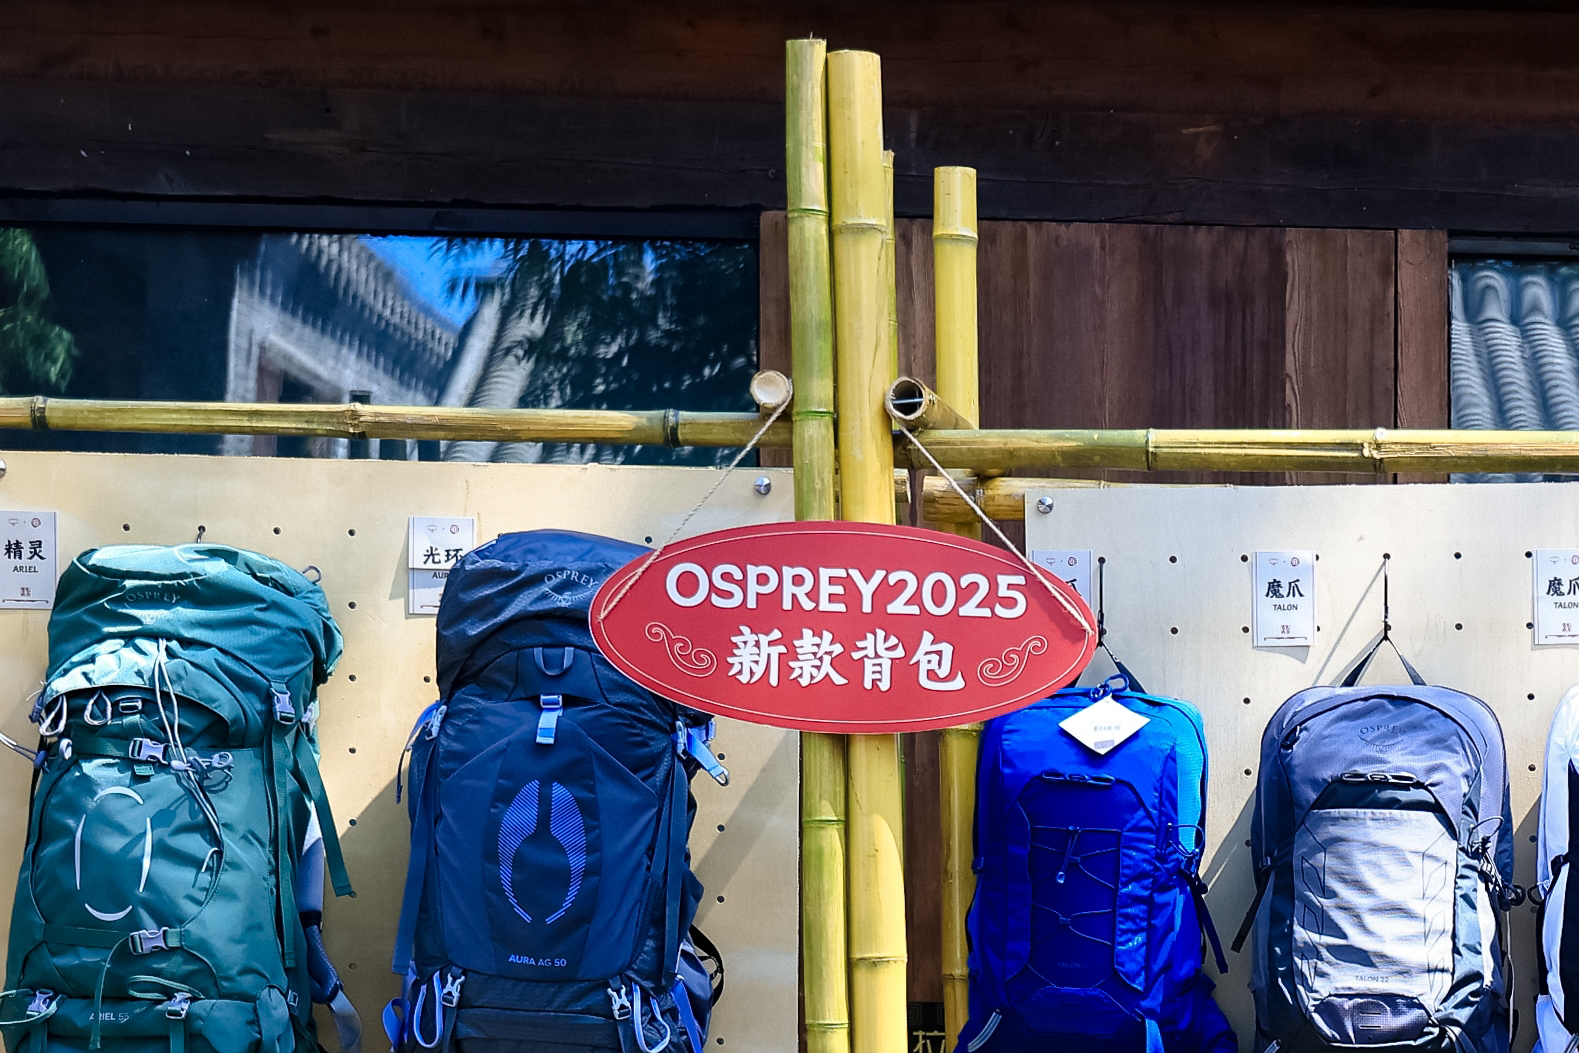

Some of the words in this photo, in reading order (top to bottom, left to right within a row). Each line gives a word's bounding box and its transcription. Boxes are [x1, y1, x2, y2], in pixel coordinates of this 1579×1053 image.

[3, 539, 47, 561] 精灵
[12, 565, 39, 573] ARIEL
[432, 572, 449, 580] AUR
[544, 570, 598, 589] OSPREY
[666, 562, 1028, 619] OSPREY2025
[1264, 579, 1305, 600] 魔爪
[126, 591, 181, 603] OSPREY
[1272, 603, 1298, 611] TALON
[1553, 601, 1579, 609] TALON
[726, 624, 966, 693] 新款背包
[508, 954, 536, 966] AURA
[537, 958, 552, 967] AG
[554, 958, 567, 967] 50
